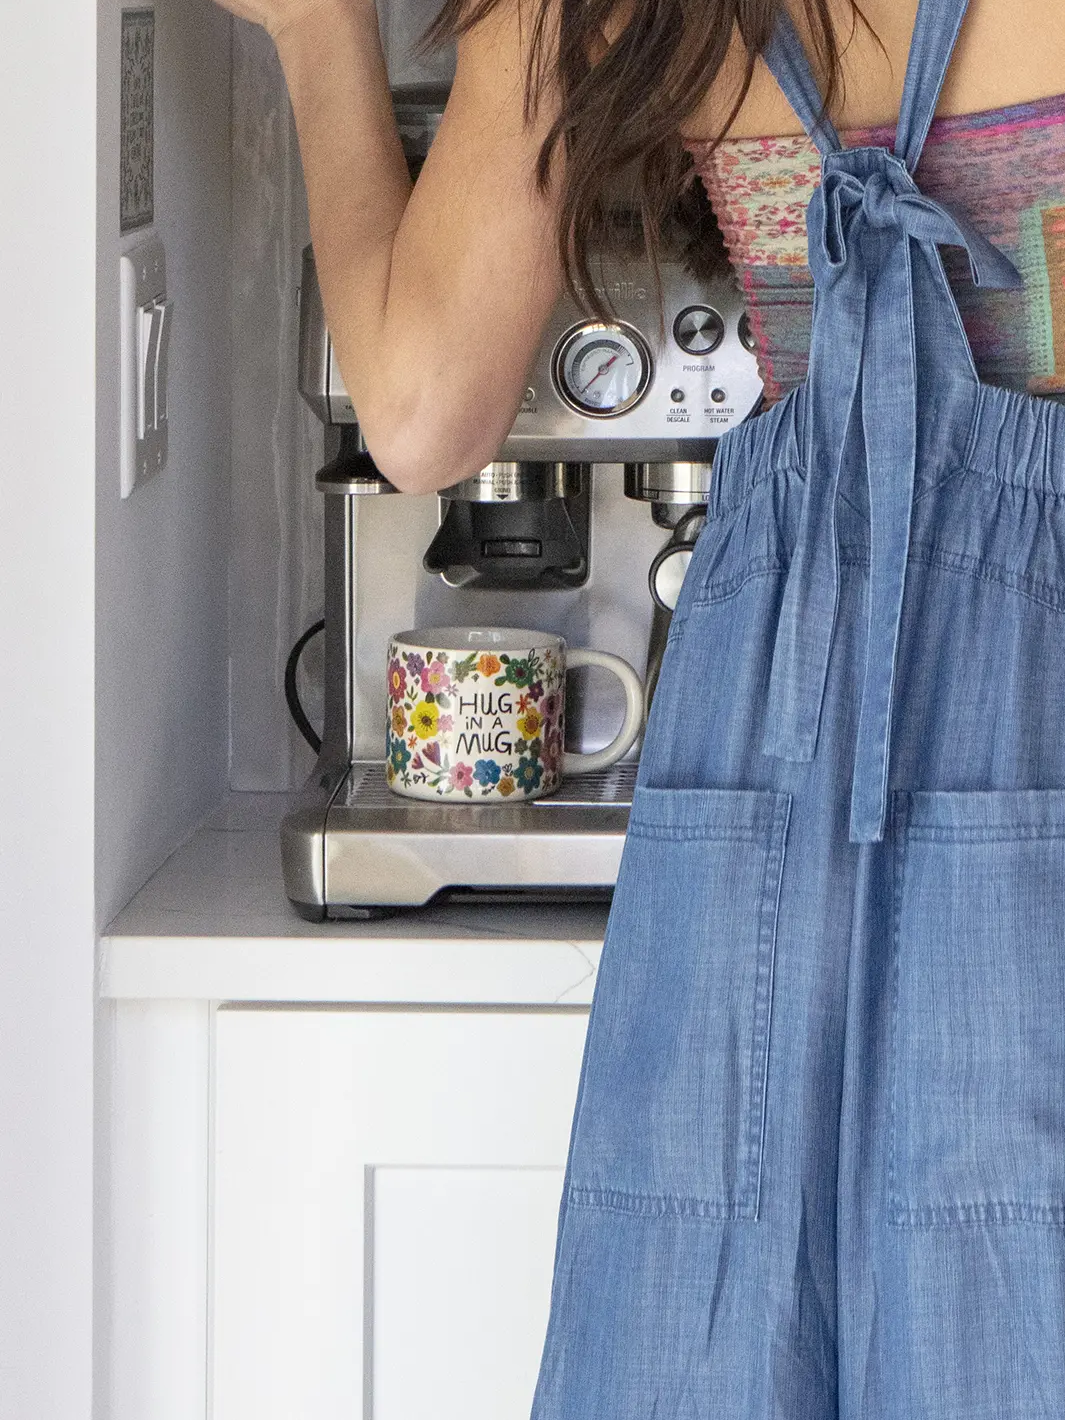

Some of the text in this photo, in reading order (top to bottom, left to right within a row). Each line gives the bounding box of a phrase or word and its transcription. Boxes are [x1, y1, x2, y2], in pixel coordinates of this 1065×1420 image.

[459, 692, 512, 716] HUG
[491, 716, 503, 729] A
[455, 731, 512, 756] MUG
